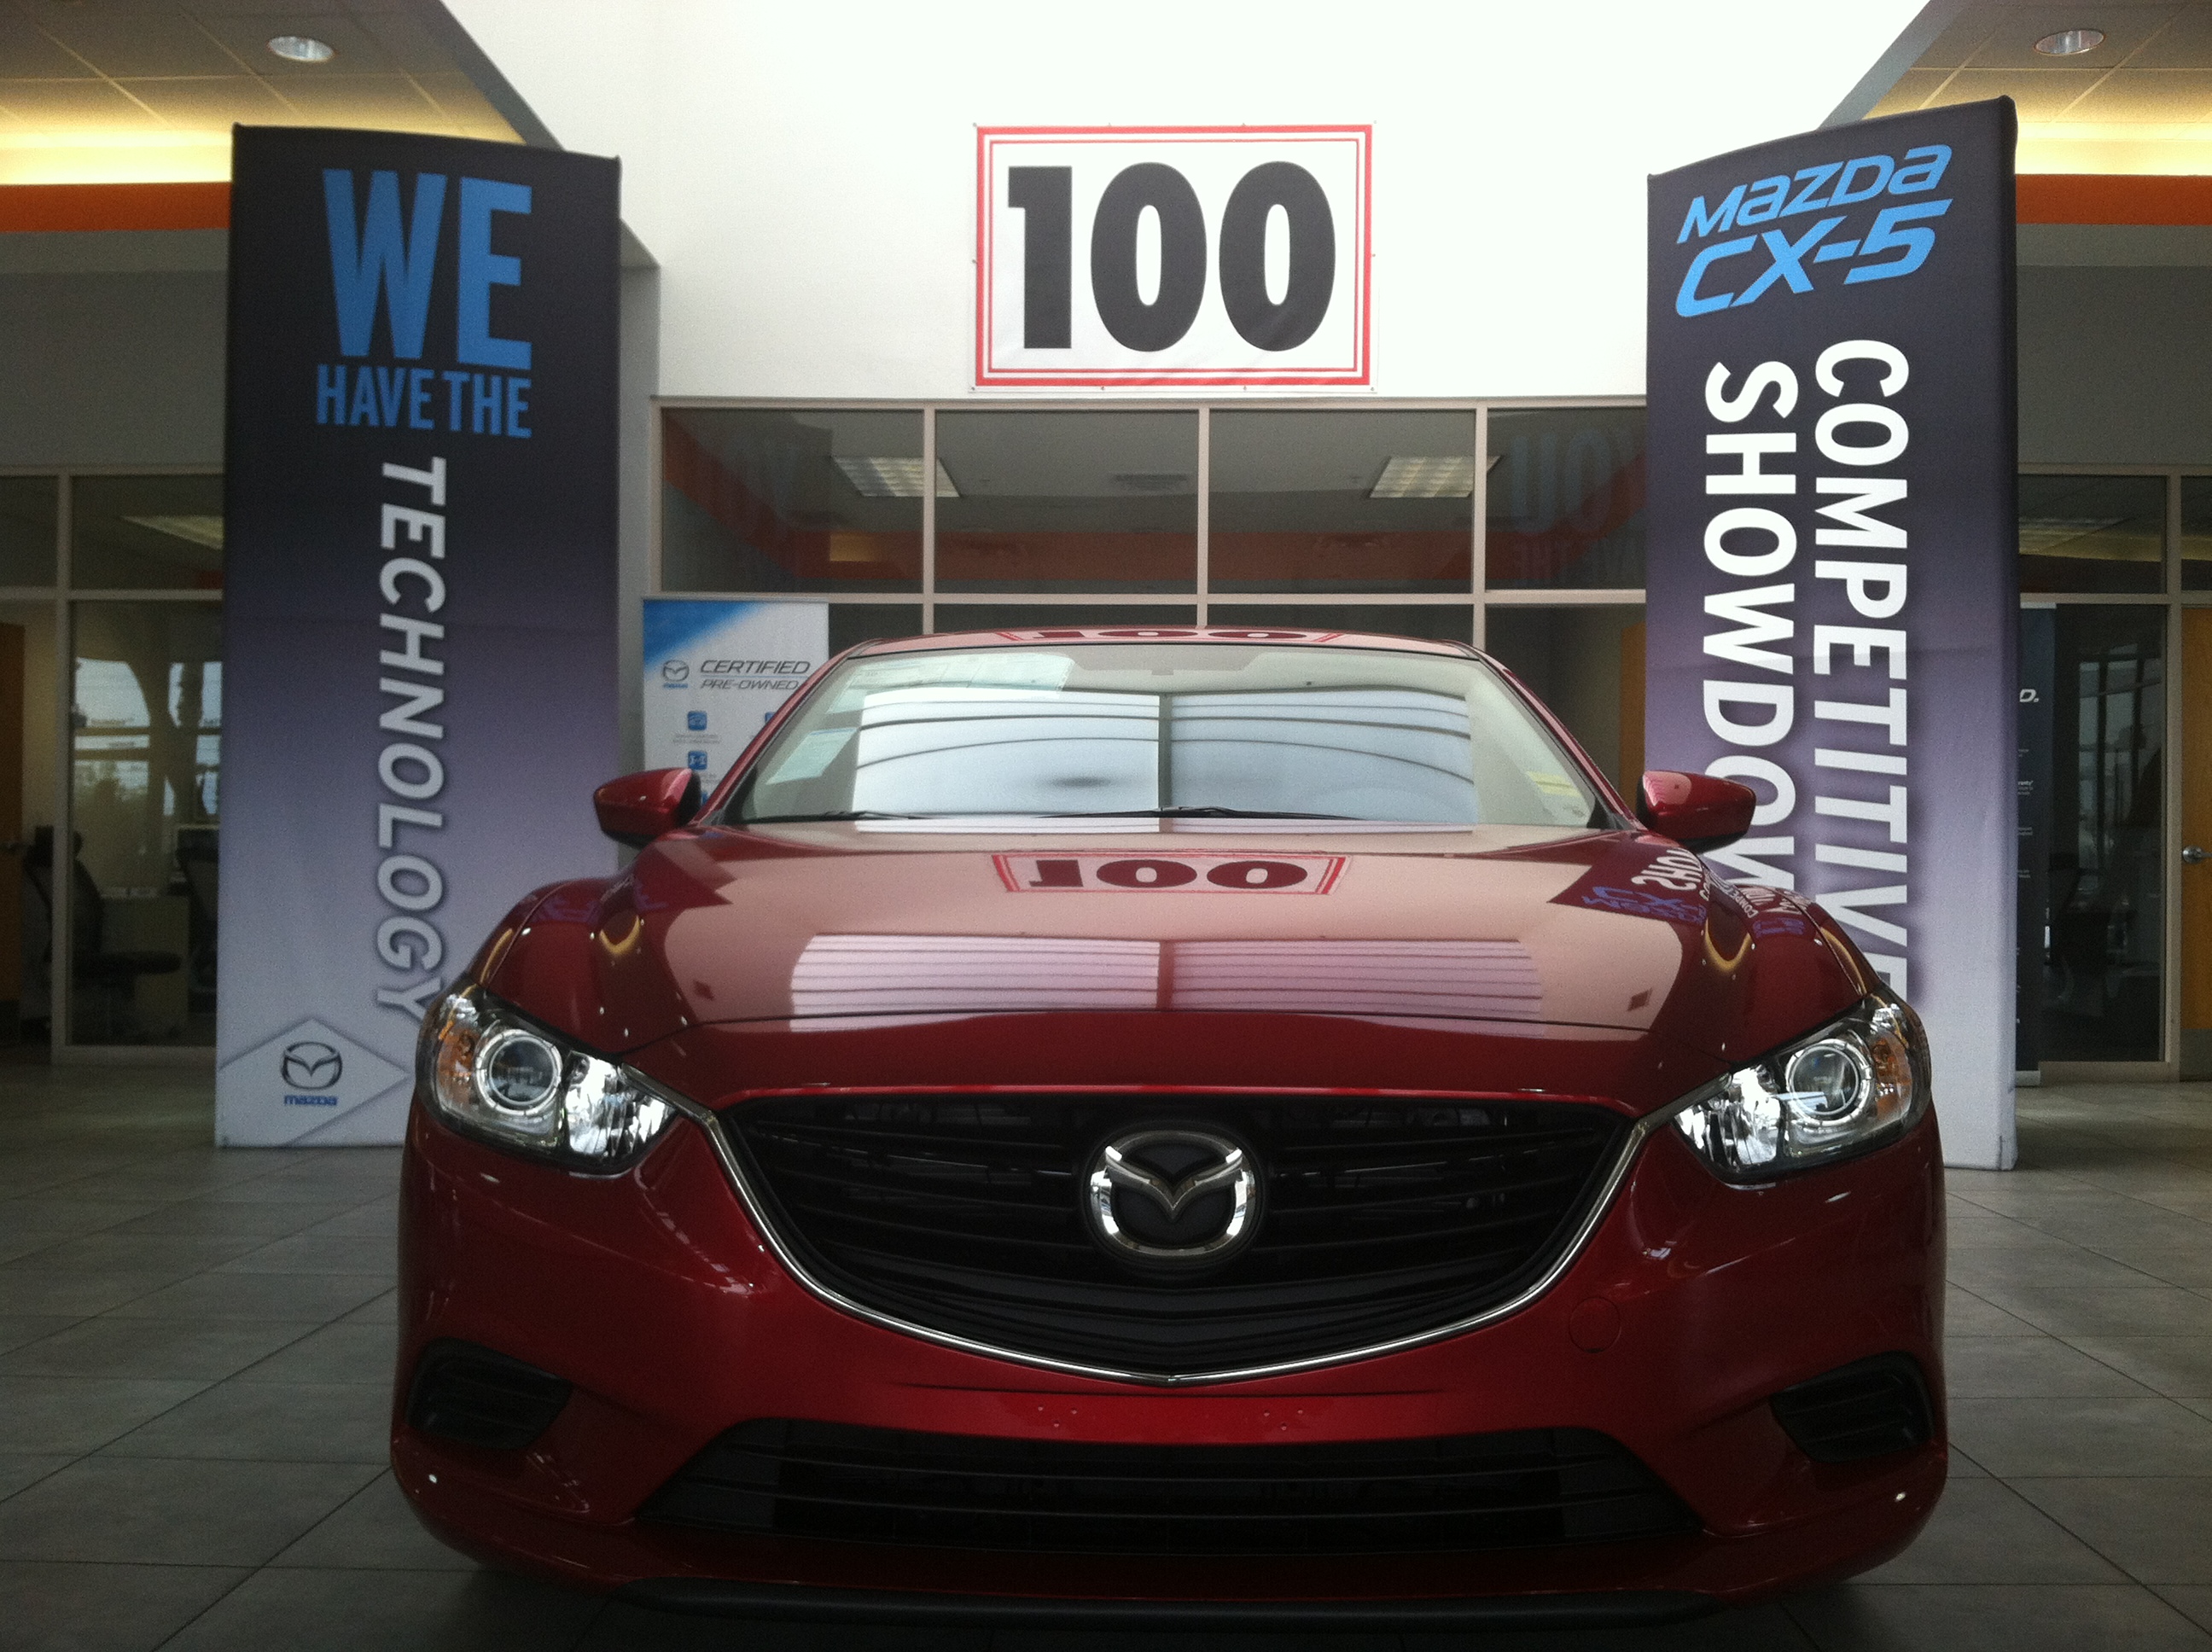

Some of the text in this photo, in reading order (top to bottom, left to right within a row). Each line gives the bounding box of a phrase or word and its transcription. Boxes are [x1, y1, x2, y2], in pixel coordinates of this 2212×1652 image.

[323, 168, 533, 370] WE
[1008, 160, 1336, 352] 100
[1674, 197, 1953, 317] CX-5
[316, 364, 533, 439] HAVE THE
[376, 456, 447, 1024] TECHNOLOGY
[700, 660, 811, 675] CERTIFIED
